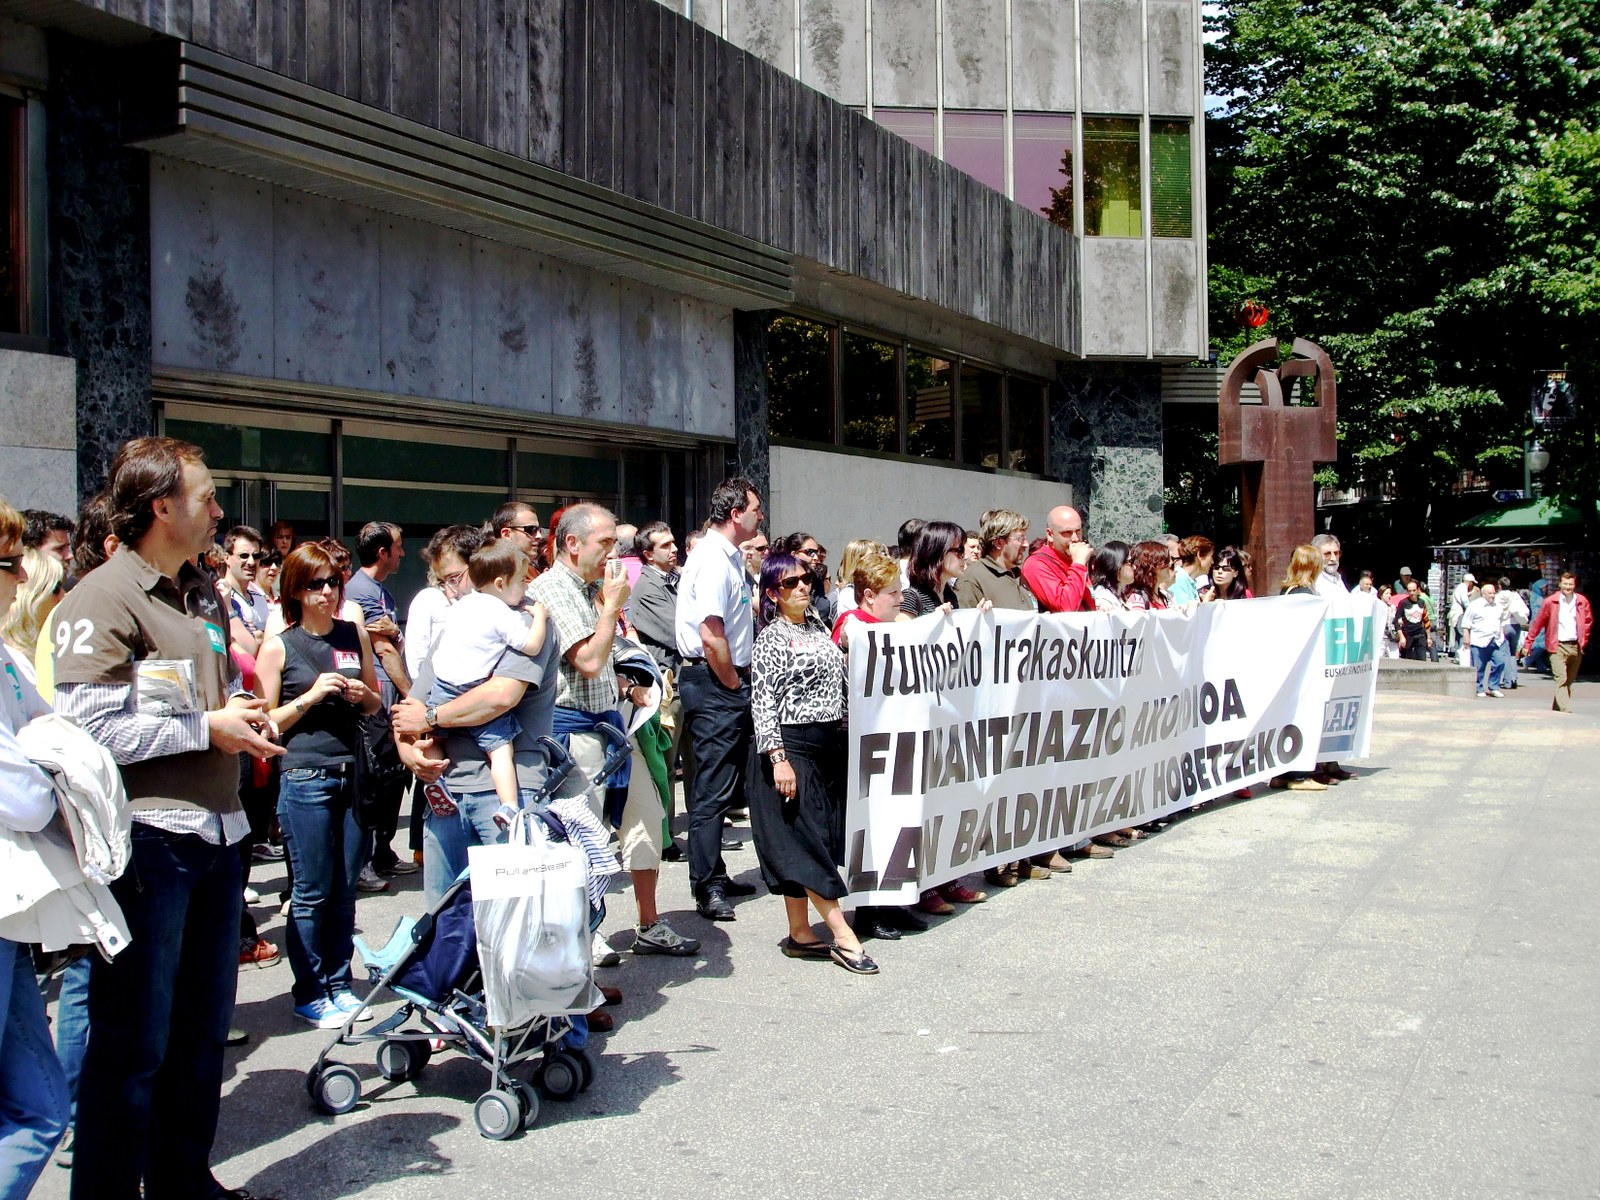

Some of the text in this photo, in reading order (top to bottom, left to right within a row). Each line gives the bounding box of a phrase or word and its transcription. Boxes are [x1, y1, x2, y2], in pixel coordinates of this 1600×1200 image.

[56, 619, 94, 658] 92
[864, 625, 1144, 706] Itunpeko Irakaskuntza
[1324, 616, 1373, 666] ELA
[859, 706, 1126, 798] FINANTZIAZIO
[848, 724, 1304, 891] LAN BALDINTZAK HOBETZEKO
